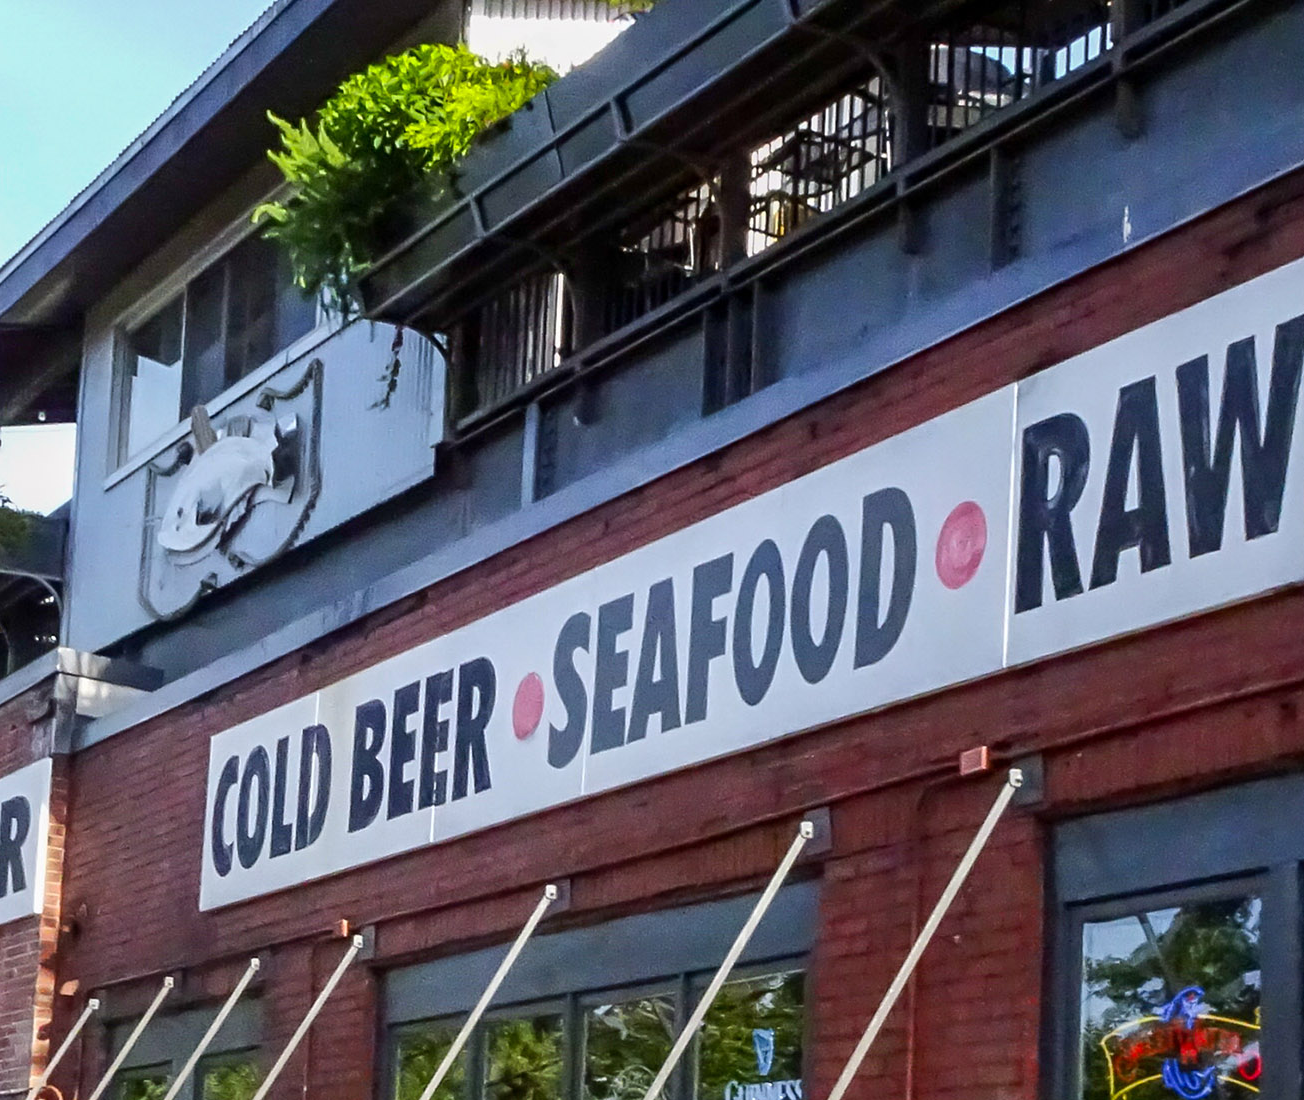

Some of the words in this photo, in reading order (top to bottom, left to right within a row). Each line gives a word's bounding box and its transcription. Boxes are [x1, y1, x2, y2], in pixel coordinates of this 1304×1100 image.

[211, 724, 332, 878] COLD
[347, 656, 496, 833] BEER
[548, 486, 917, 769] SEAFOOD
